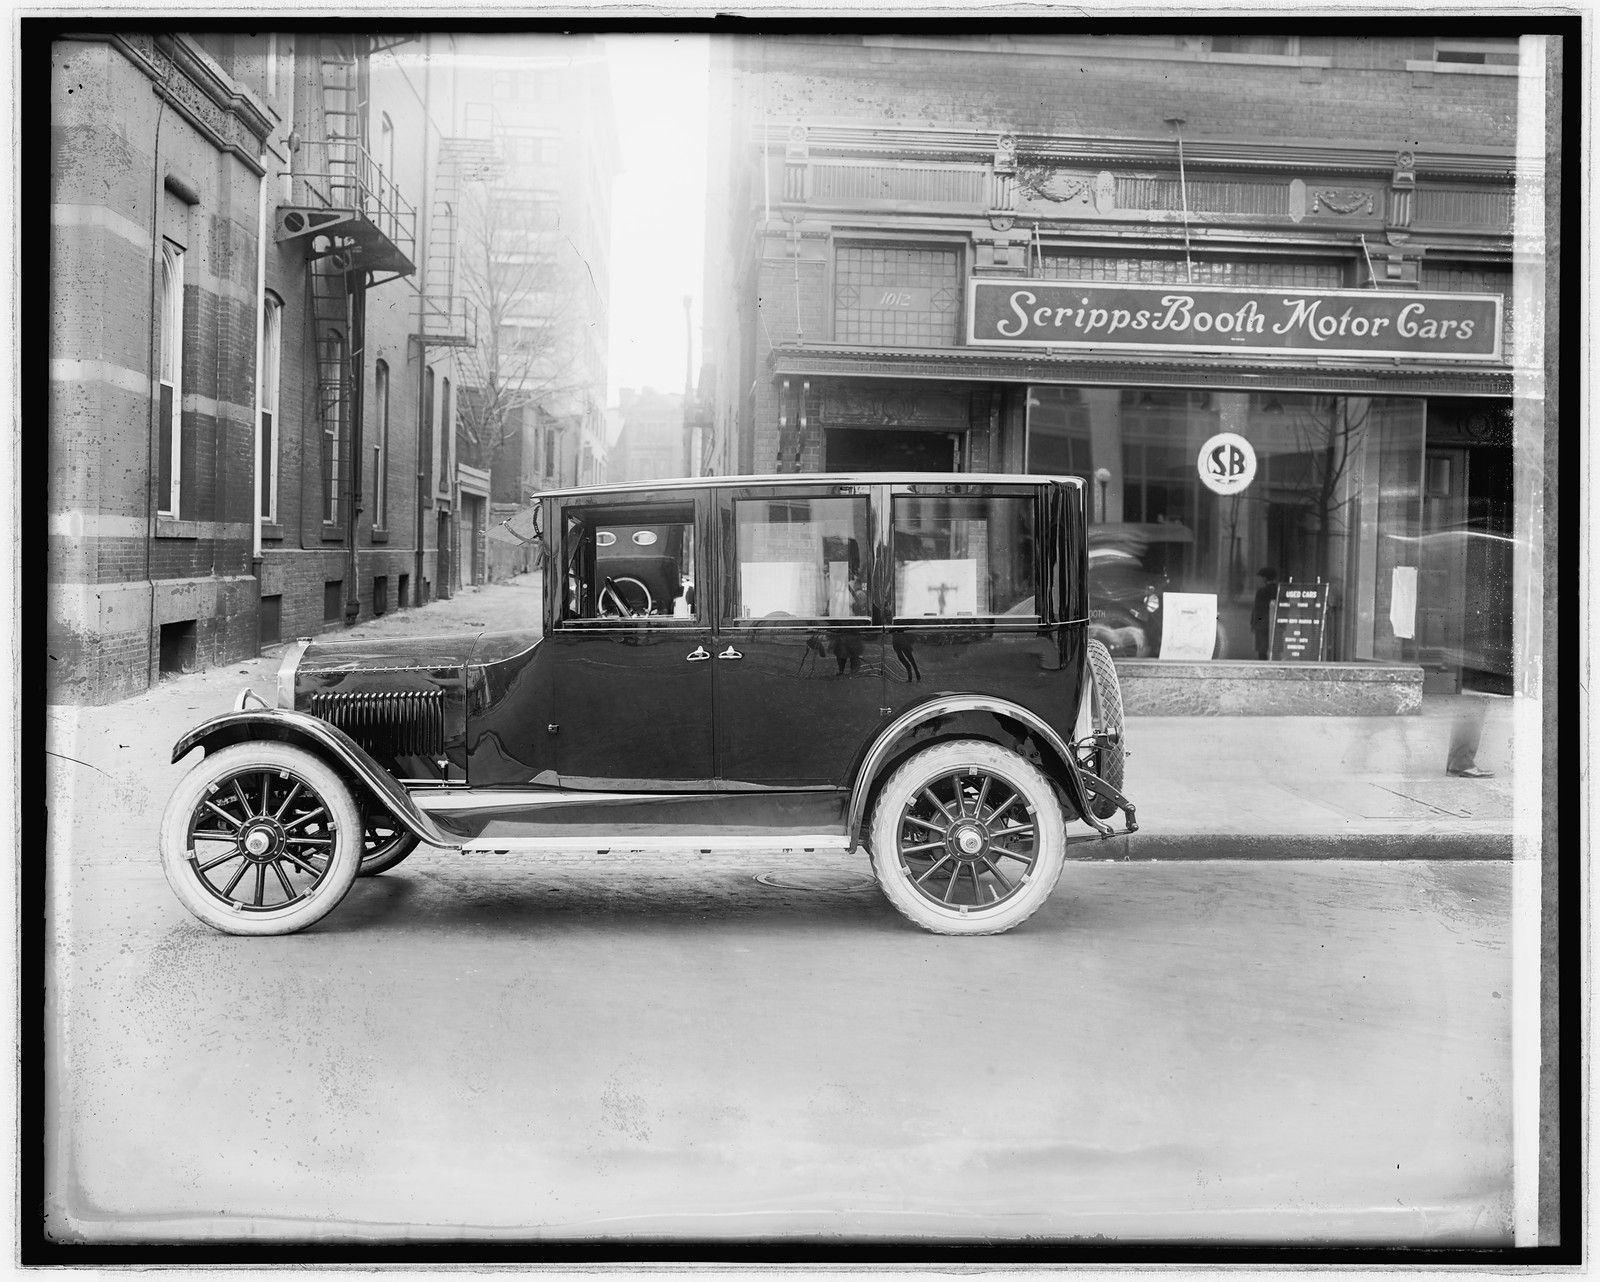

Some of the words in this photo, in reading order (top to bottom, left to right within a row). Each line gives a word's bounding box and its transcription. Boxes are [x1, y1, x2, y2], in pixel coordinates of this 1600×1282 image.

[880, 291, 911, 307] 1012
[1272, 298, 1390, 341] Motor
[1397, 302, 1475, 340] Cars
[1211, 444, 1246, 477] SB
[1285, 590, 1301, 598] USED
[1302, 590, 1318, 598] CARS
